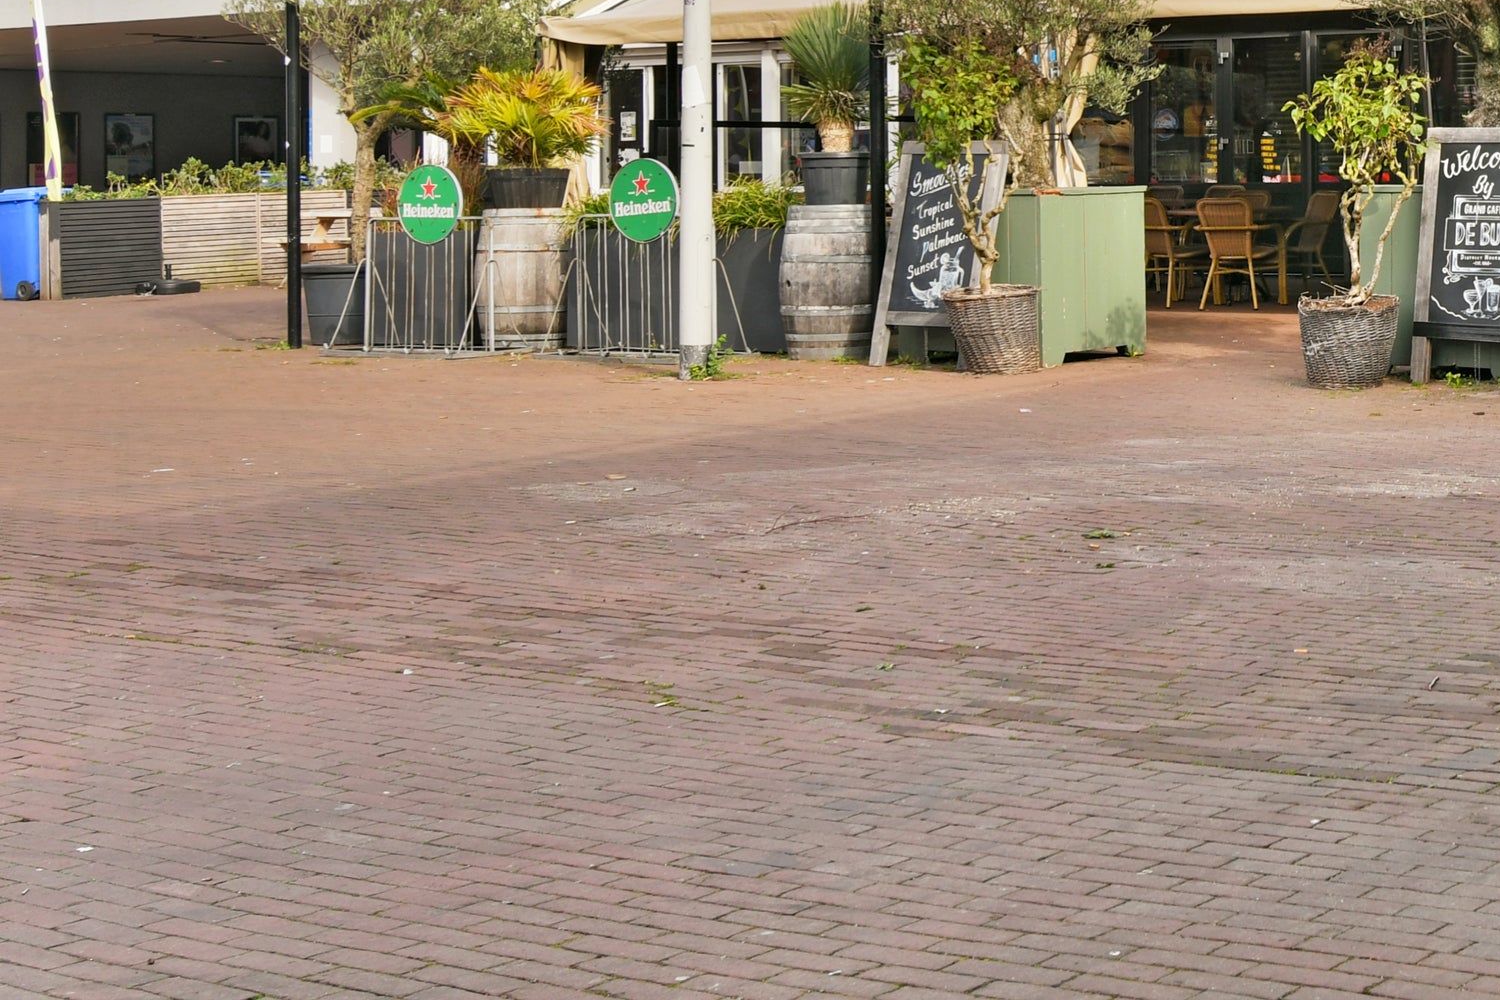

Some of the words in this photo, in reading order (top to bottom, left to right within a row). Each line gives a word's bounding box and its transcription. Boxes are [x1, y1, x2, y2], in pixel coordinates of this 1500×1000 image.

[1472, 175, 1494, 199] By
[402, 202, 455, 219] Heineken
[614, 198, 672, 218] Heineken
[916, 194, 954, 221] Tropical
[912, 217, 955, 241] Sunshine
[1454, 221, 1477, 246] DE
[906, 253, 940, 280] Sunset
